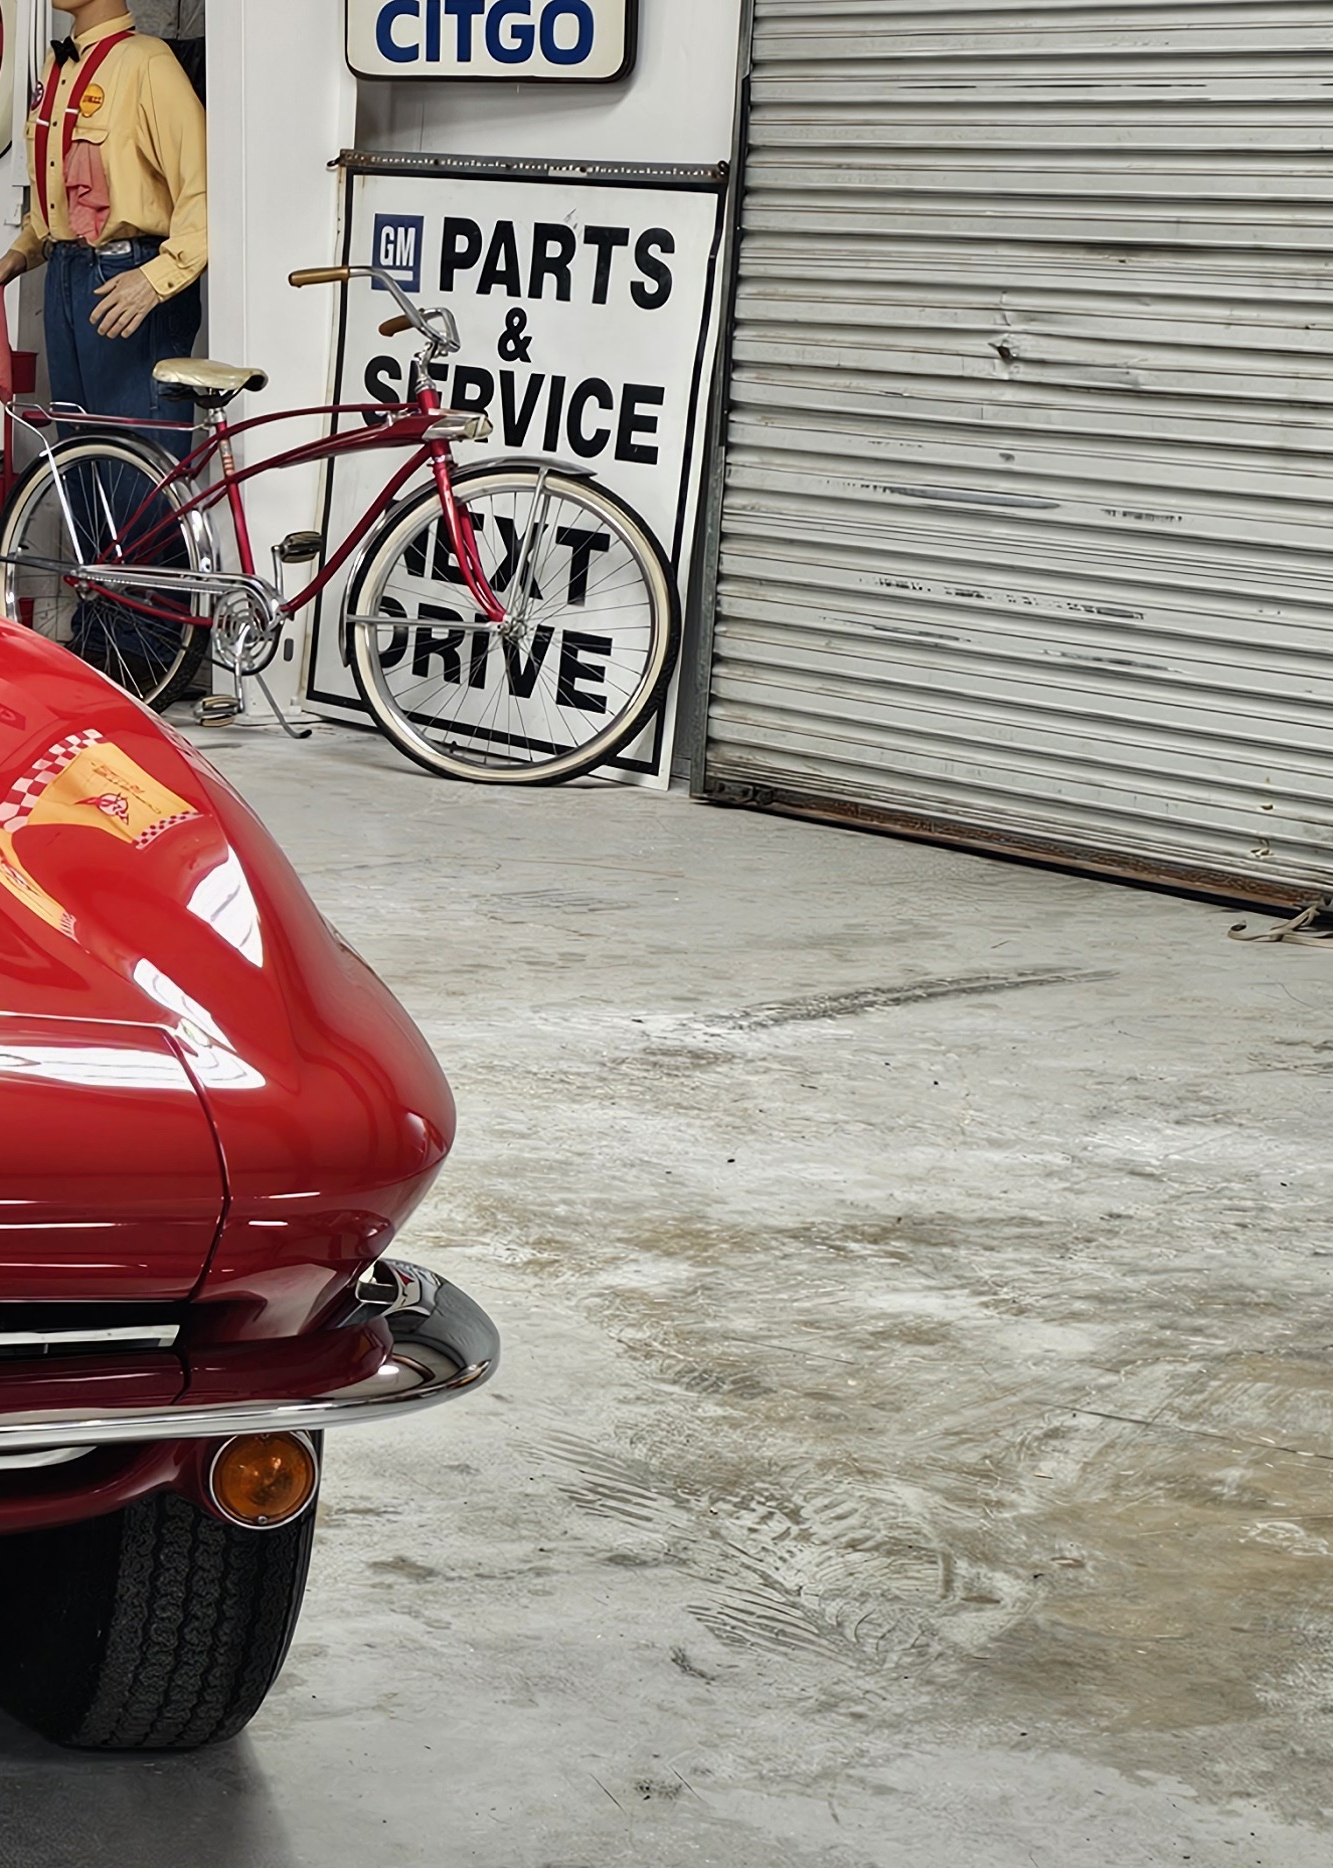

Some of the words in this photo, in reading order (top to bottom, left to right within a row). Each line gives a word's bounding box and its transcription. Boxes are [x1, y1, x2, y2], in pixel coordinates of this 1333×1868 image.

[375, 0, 595, 65] CITGO
[382, 225, 416, 267] GM
[439, 216, 676, 311] PARTS
[497, 307, 533, 364] &
